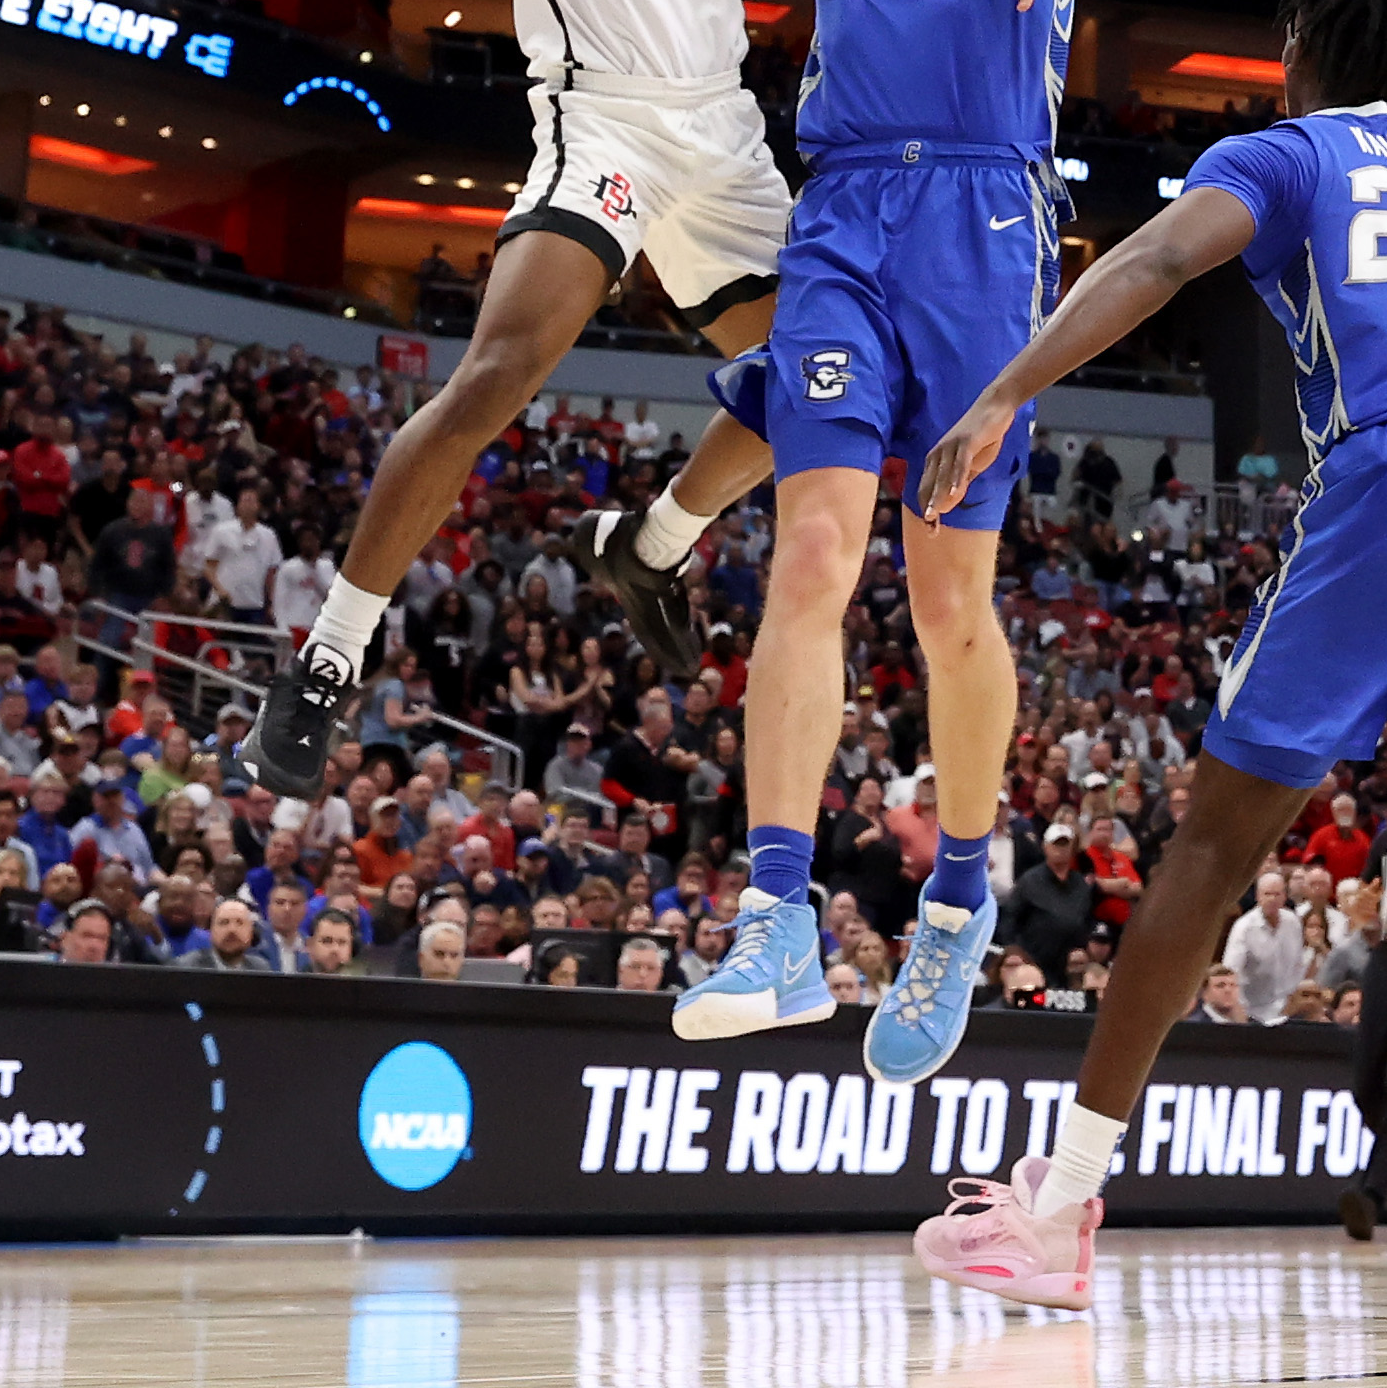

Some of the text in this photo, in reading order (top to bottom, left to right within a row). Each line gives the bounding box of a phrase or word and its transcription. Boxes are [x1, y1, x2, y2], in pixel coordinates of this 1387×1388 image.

[369, 1112, 468, 1150] NCAA
[580, 1065, 721, 1174] THE
[724, 1069, 917, 1175] ROAD
[929, 1077, 1011, 1175] TO
[1137, 1082, 1288, 1177] FINAL
